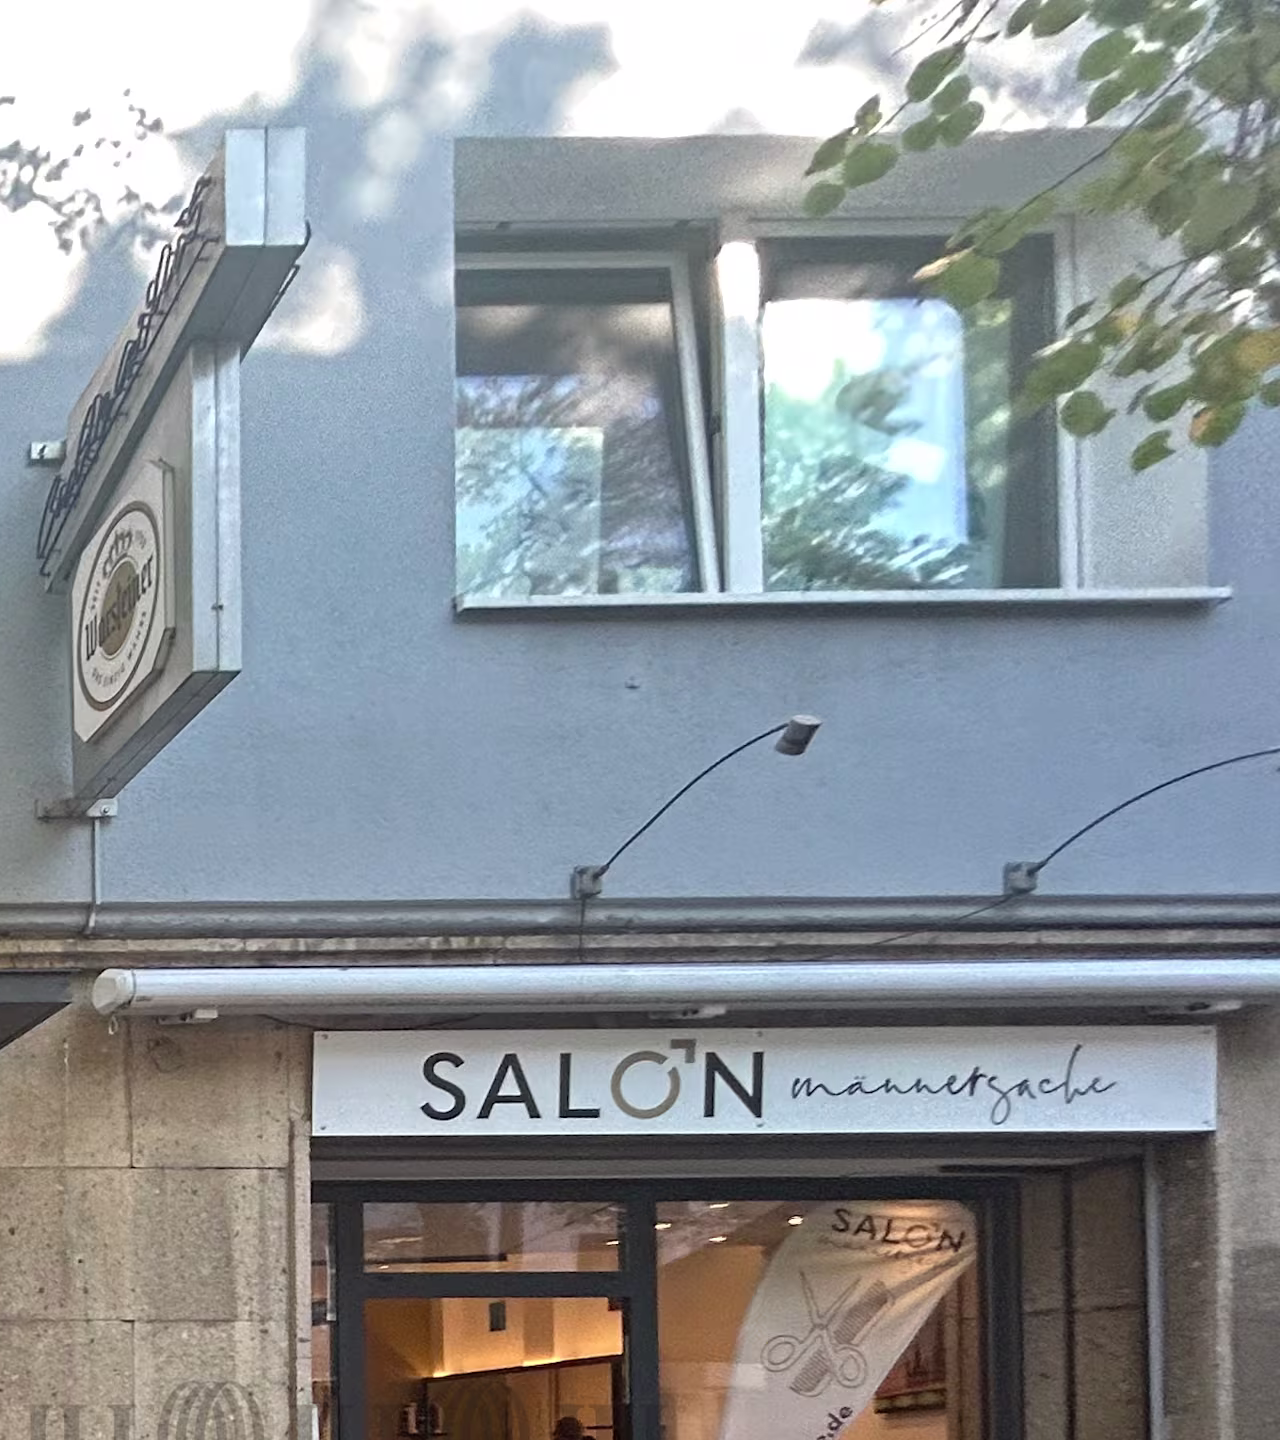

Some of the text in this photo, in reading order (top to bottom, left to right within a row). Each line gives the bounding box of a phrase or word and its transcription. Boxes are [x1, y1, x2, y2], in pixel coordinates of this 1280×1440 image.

[85, 555, 153, 661] Warsteiner
[420, 1044, 1116, 1125] SALON männersache
[831, 1207, 966, 1253] SALON
